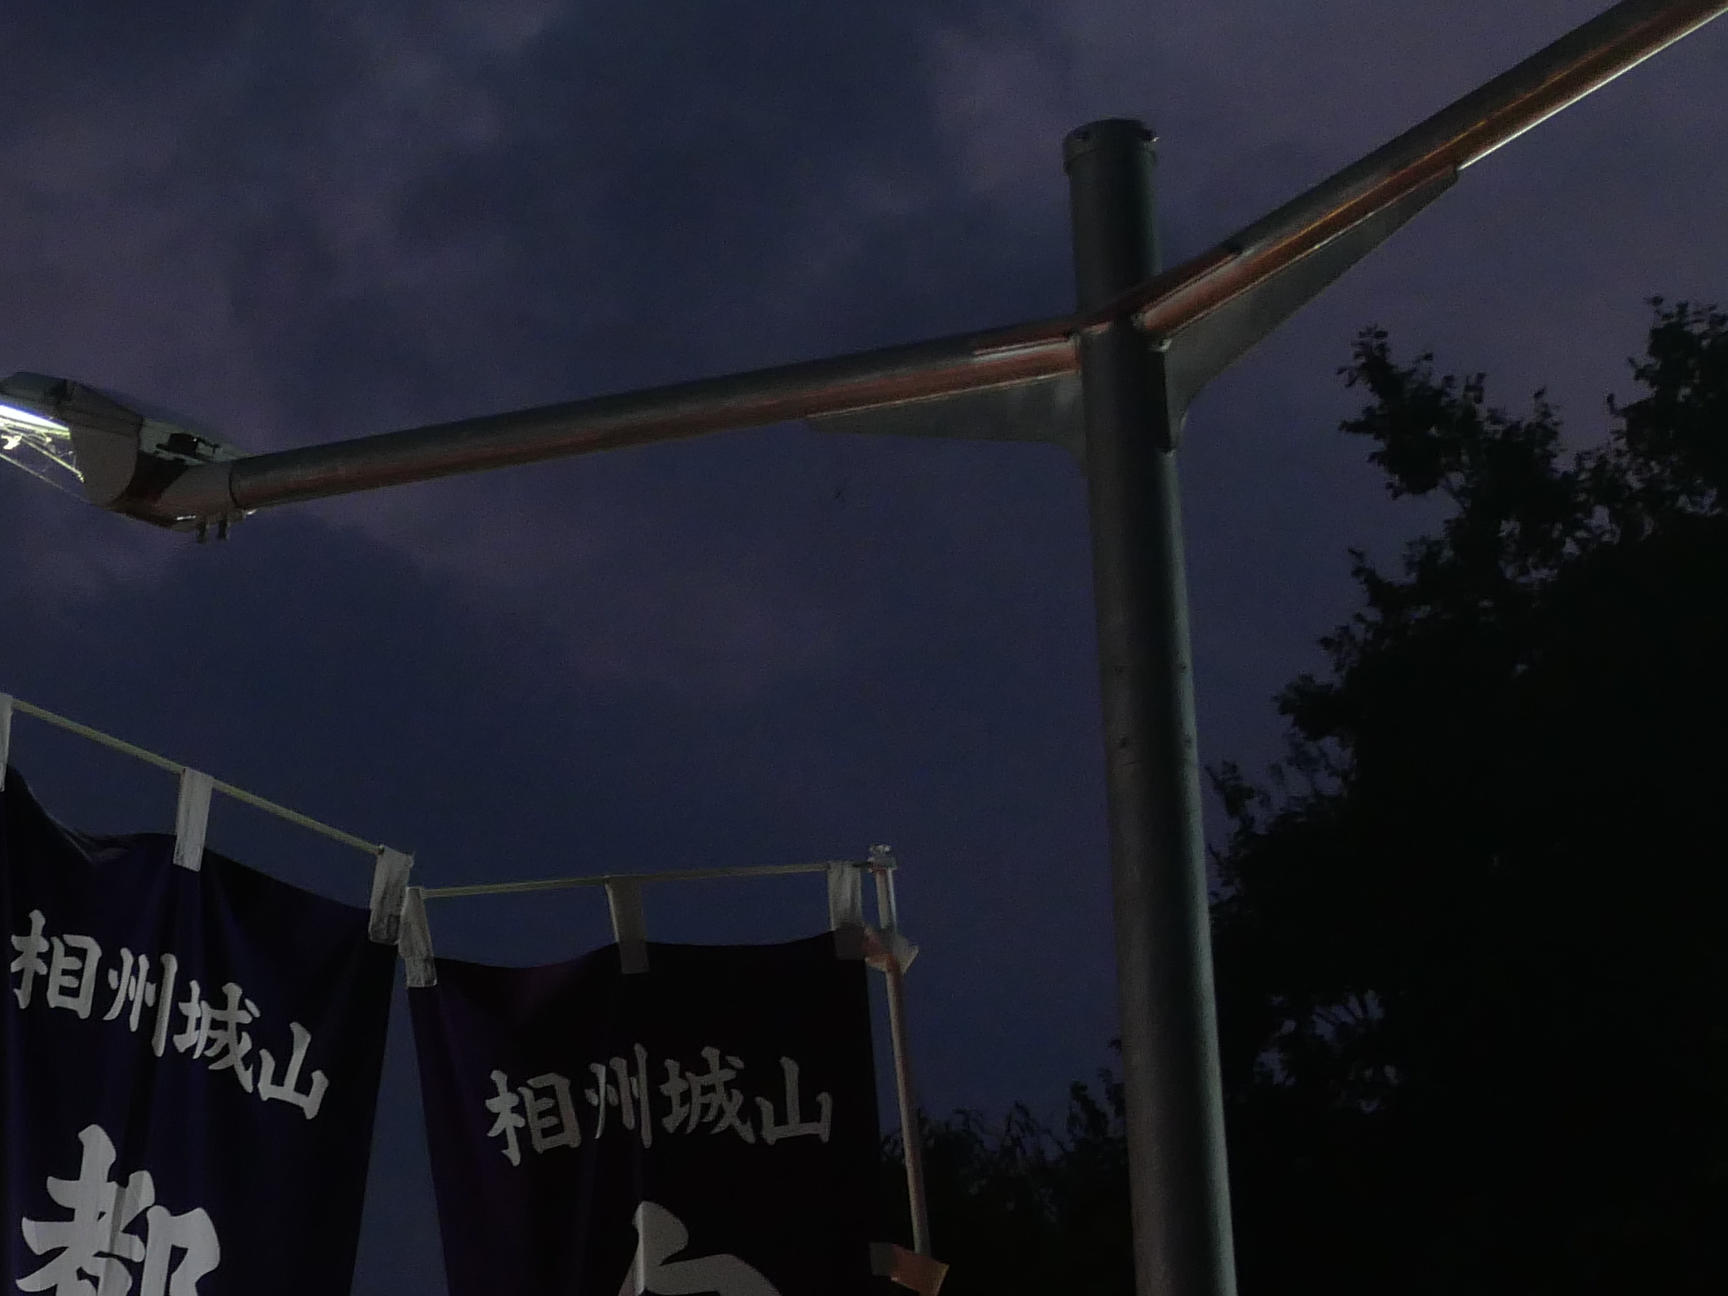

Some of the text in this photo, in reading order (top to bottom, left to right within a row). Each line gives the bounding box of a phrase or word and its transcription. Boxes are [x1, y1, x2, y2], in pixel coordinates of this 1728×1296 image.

[8, 909, 332, 1121] 相州城山
[482, 1043, 835, 1168] 相州城山
